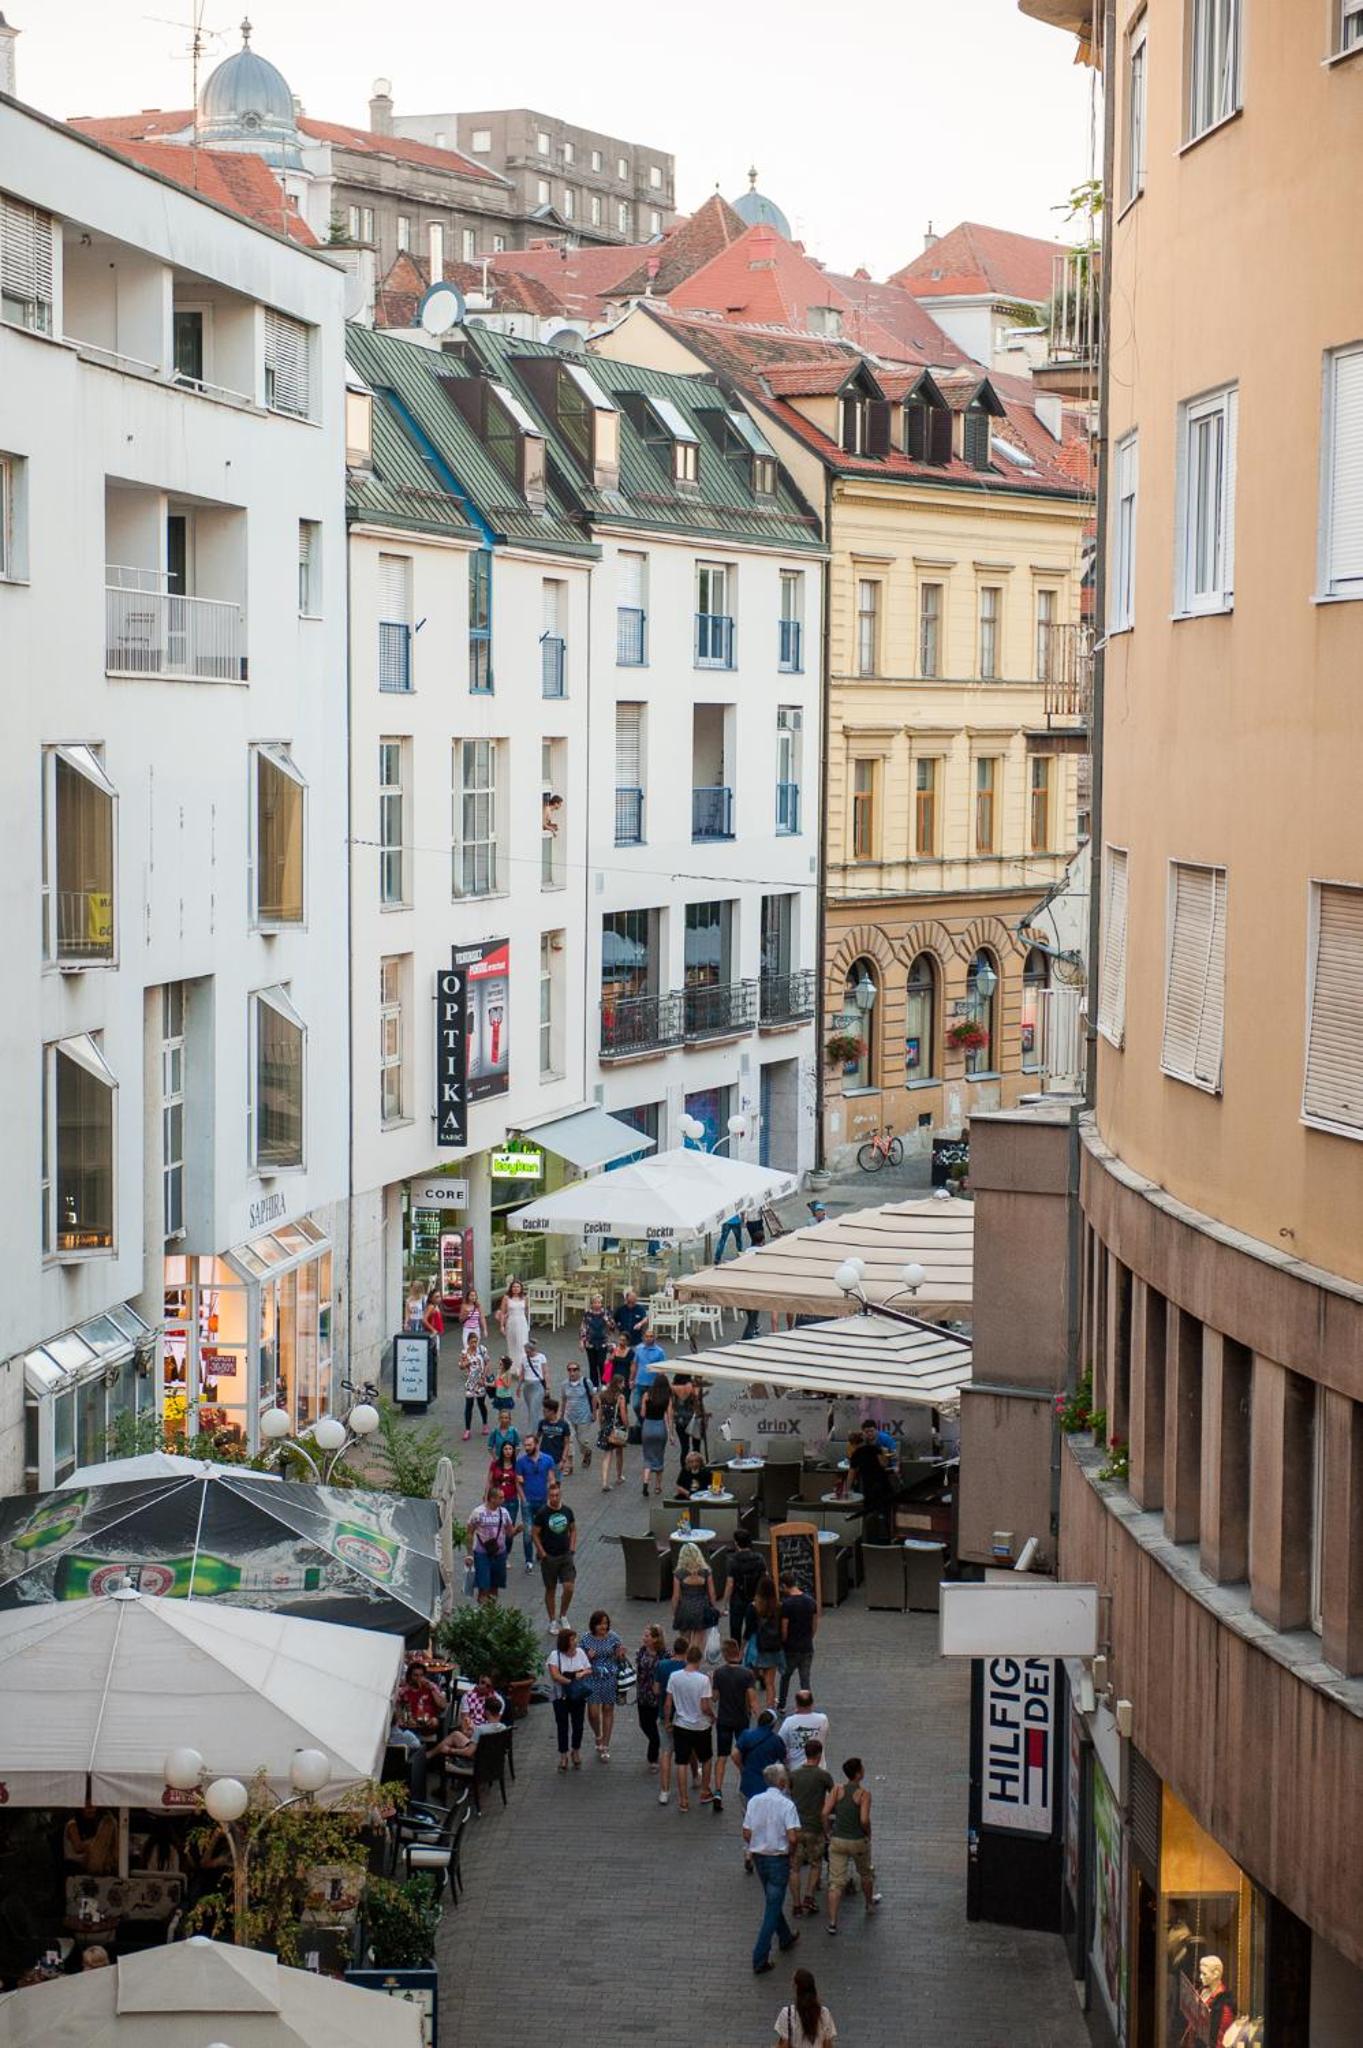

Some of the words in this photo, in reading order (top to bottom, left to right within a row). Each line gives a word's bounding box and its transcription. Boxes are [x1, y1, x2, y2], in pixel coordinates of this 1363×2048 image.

[441, 975, 461, 1130] OPTIKA
[425, 1188, 464, 1200] CORE
[249, 1192, 286, 1229] SAPHIRA
[757, 1418, 799, 1434] drinX
